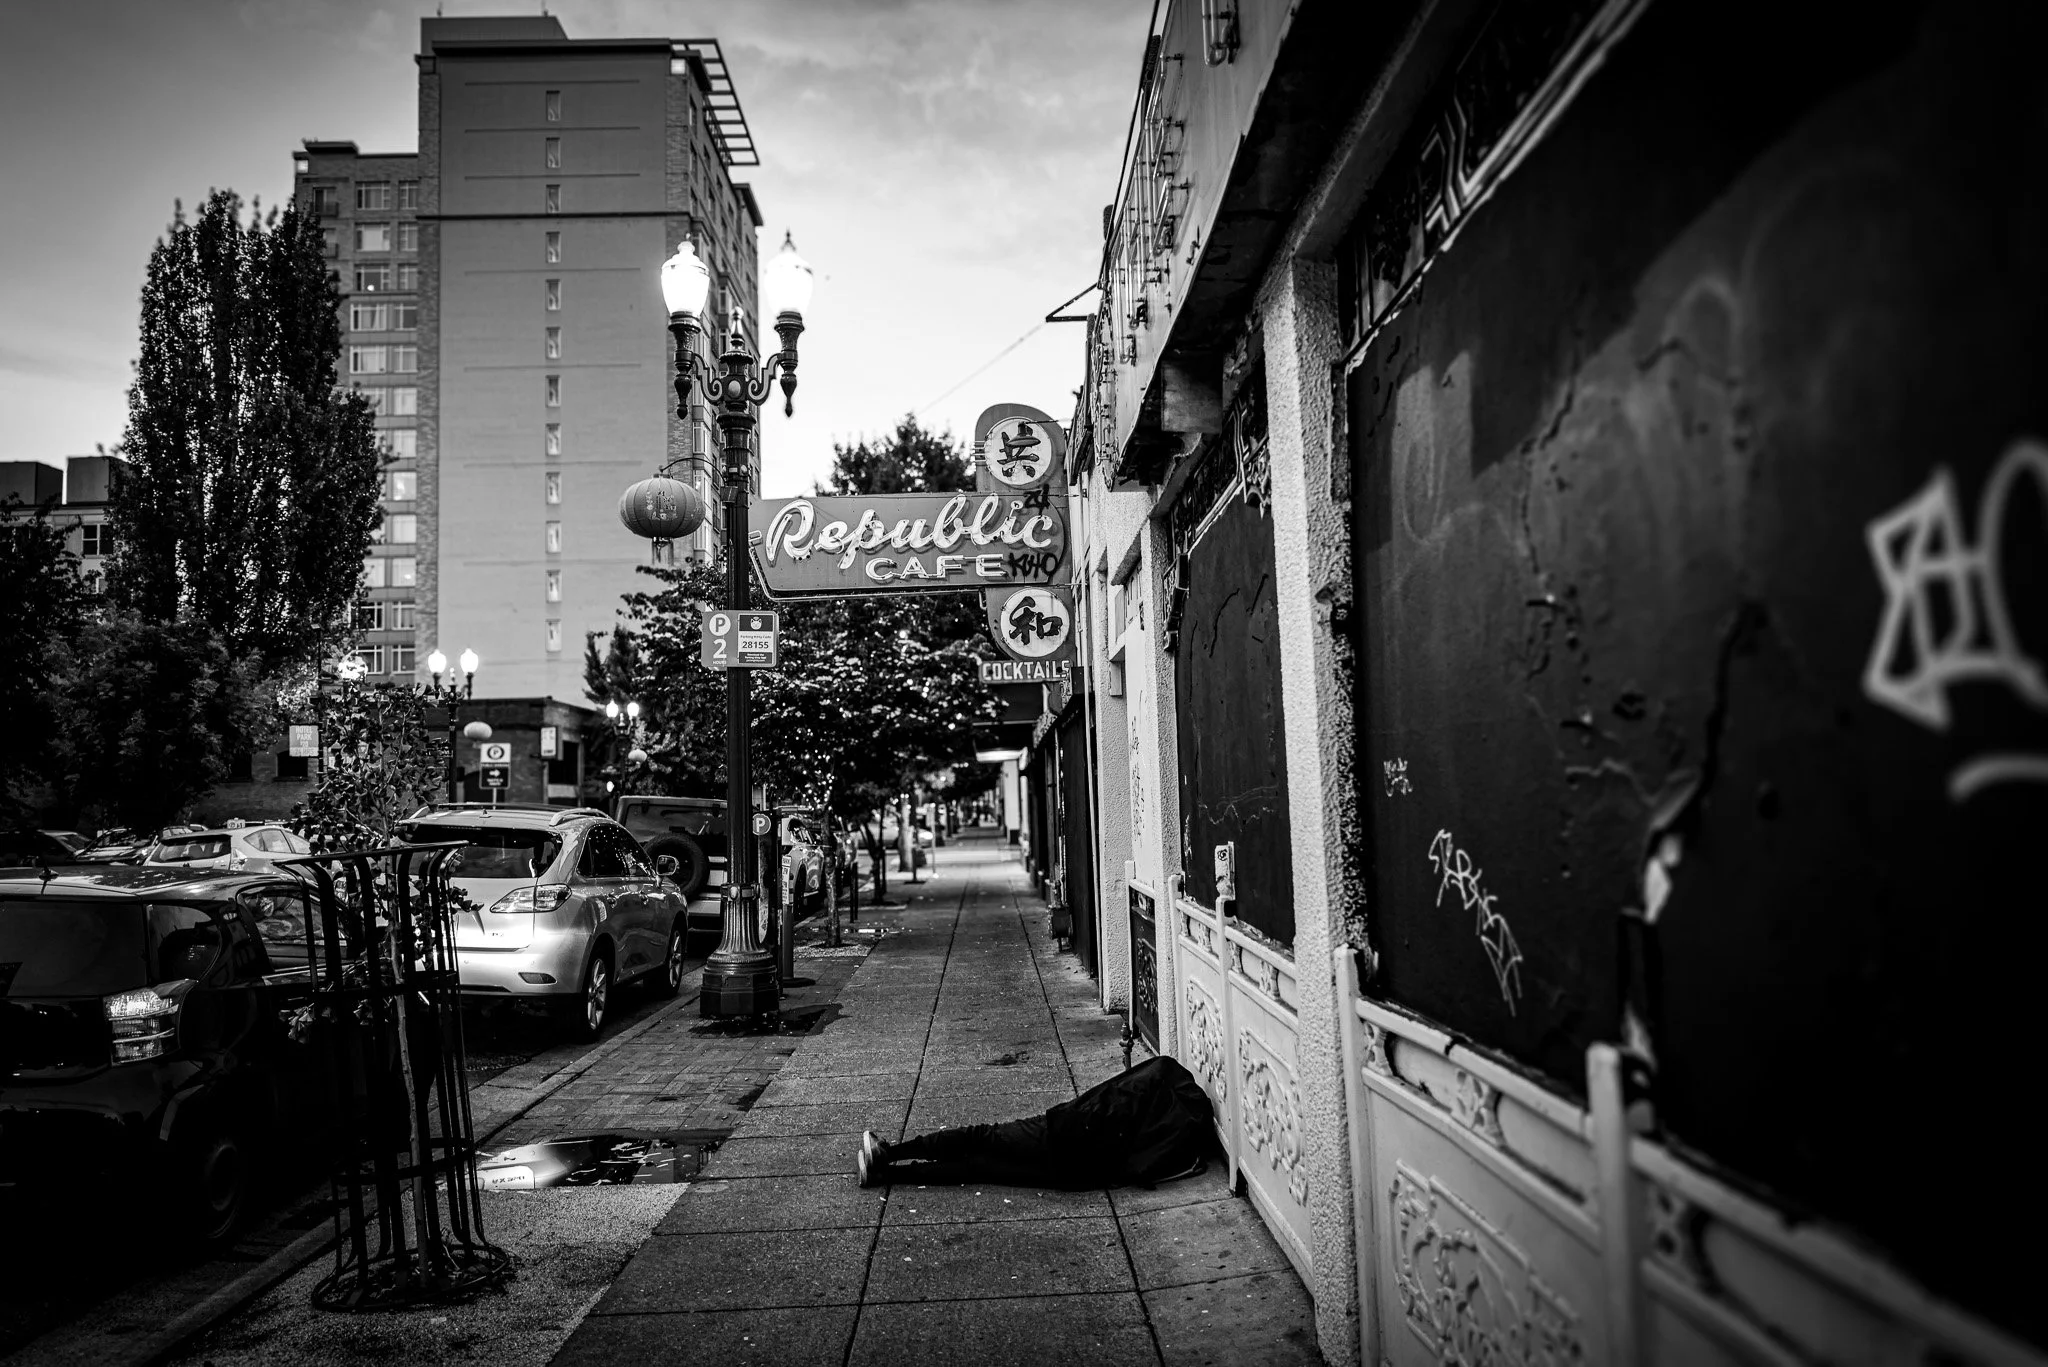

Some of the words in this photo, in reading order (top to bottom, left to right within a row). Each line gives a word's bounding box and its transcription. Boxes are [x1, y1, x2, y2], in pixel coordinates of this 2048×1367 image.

[765, 492, 1053, 570] Republic
[865, 553, 1006, 580] CAFE
[715, 617, 726, 633] P
[1008, 595, 1063, 646] 和
[713, 638, 727, 659] 2
[742, 640, 769, 649] 28155
[982, 660, 1070, 680] COCKTAILS
[756, 817, 766, 833] P
